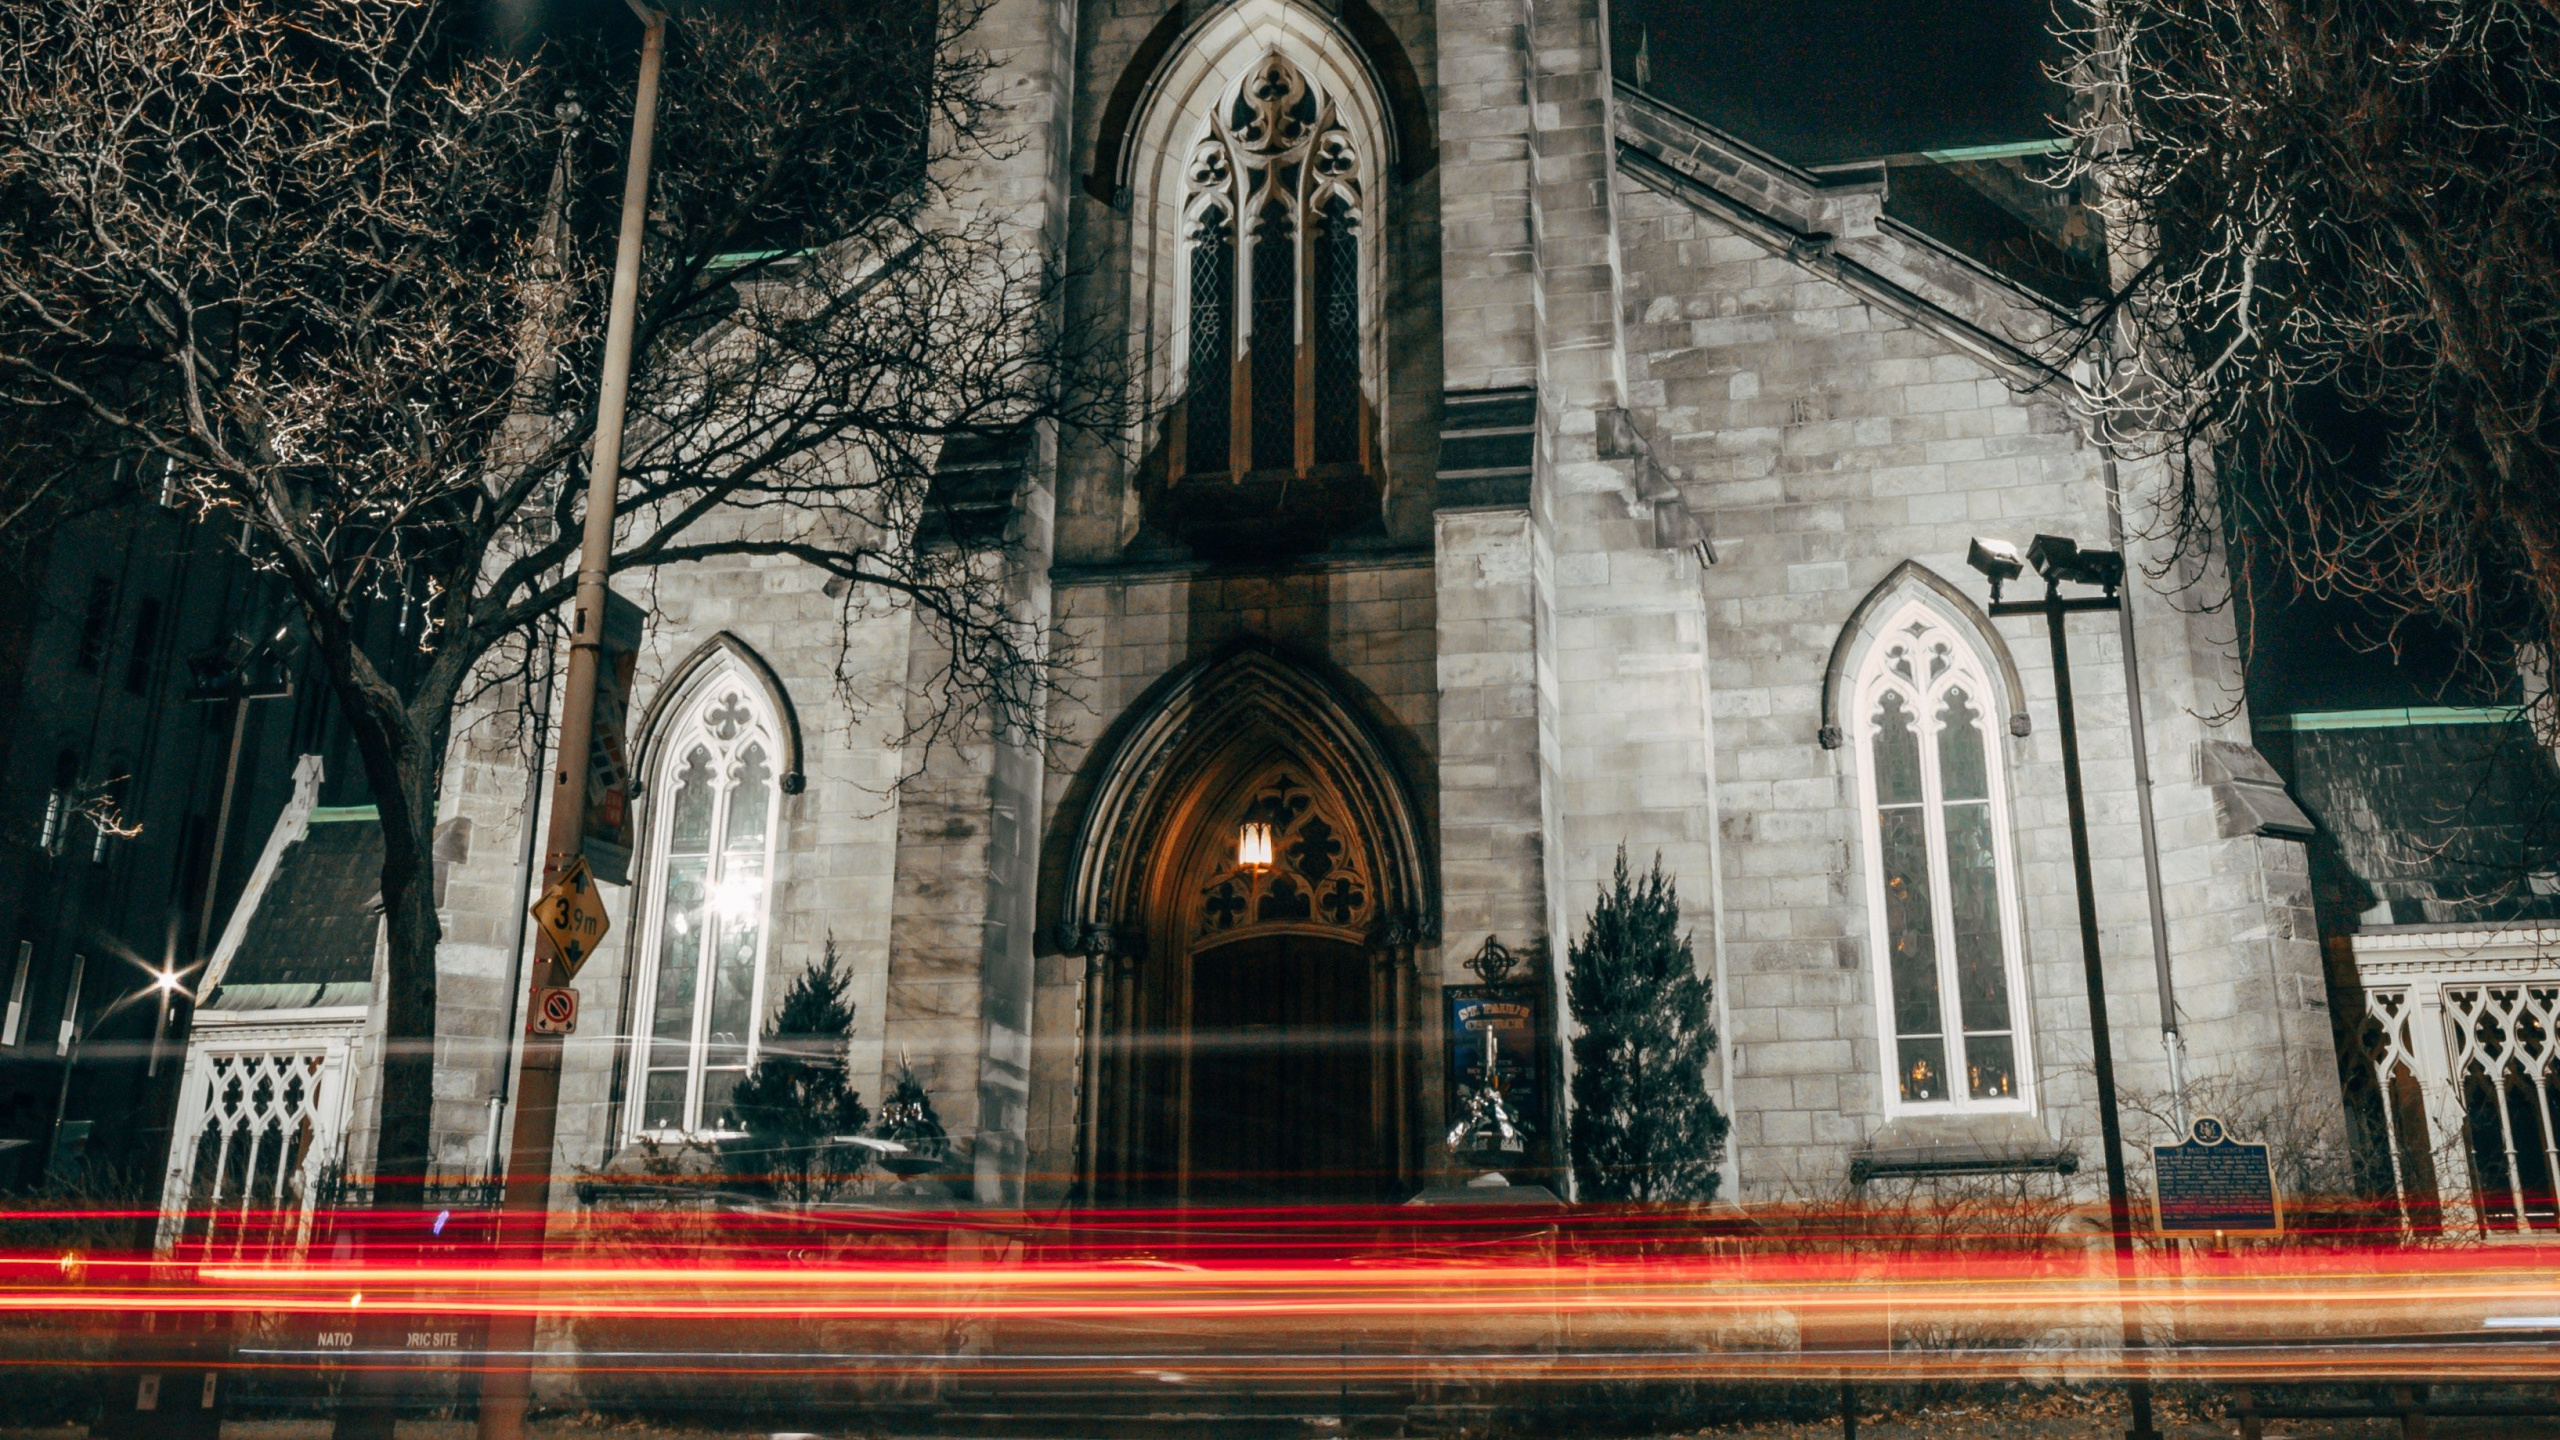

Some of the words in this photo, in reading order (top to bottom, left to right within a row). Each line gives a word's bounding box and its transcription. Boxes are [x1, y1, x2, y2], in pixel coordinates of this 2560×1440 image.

[1483, 1003, 1530, 1018] PAUL'S
[1465, 1018, 1525, 1031] CHURCH
[318, 1333, 353, 1346] NATIO
[433, 1333, 457, 1346] SITE
